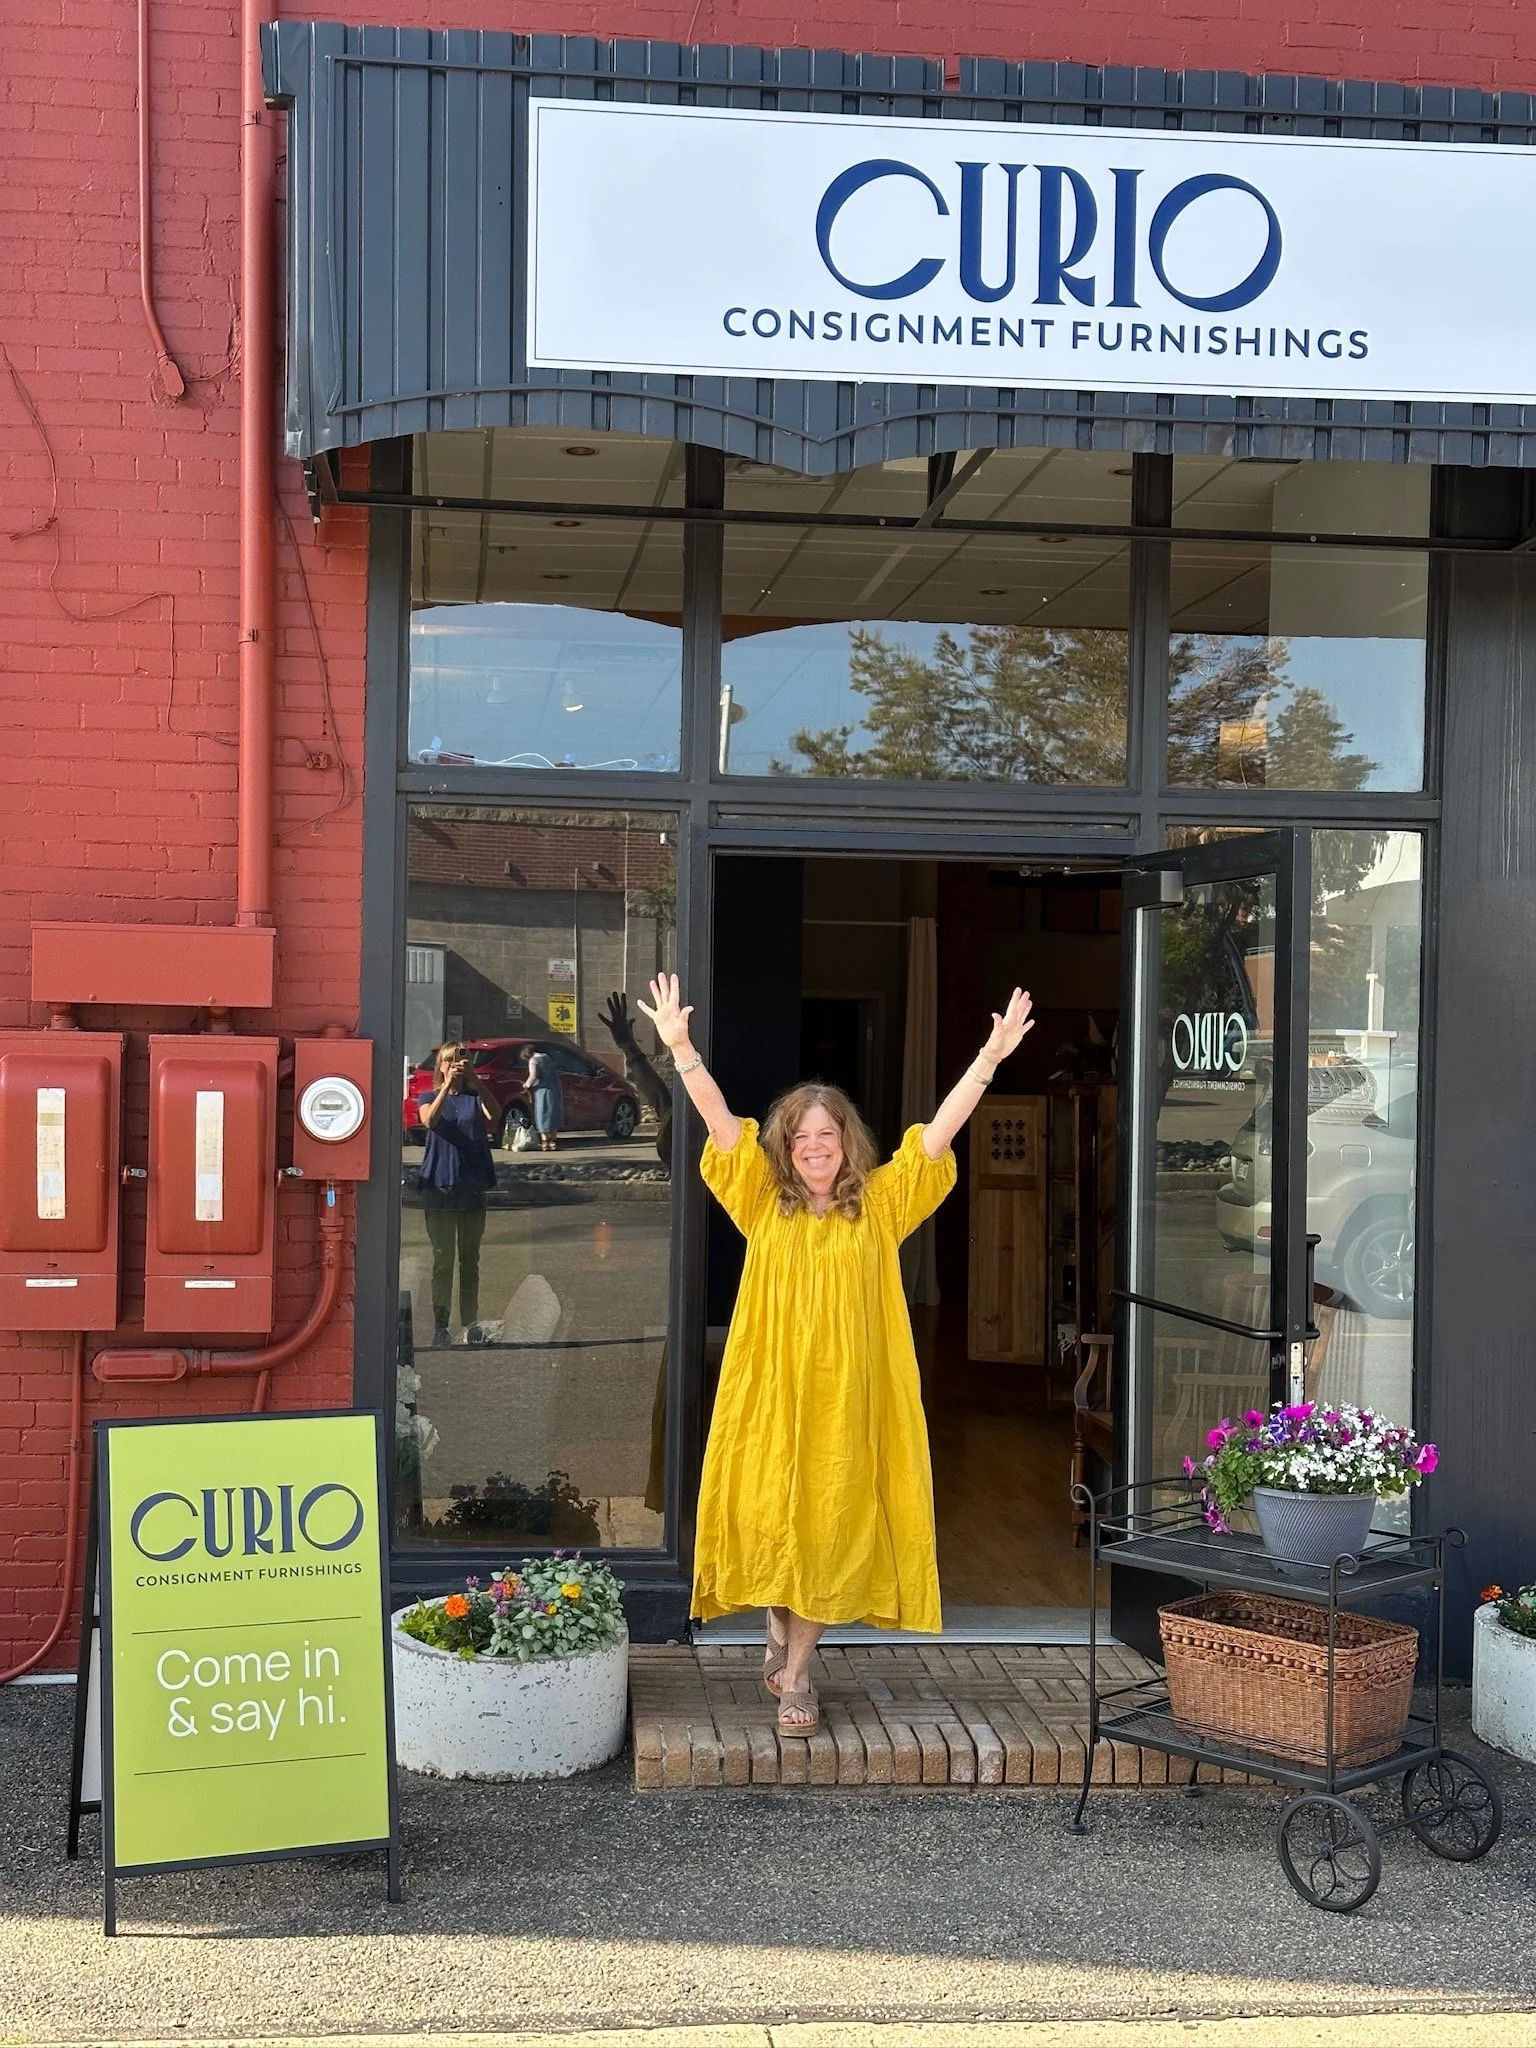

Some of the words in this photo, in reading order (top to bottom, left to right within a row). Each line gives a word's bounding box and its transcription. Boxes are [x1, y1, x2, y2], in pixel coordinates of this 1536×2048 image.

[815, 158, 1283, 313] CURIO
[723, 307, 1055, 349] CONSIGNMENT
[1072, 320, 1369, 360] FURNISHINGS
[130, 1483, 364, 1562] CURIO
[136, 1569, 254, 1587] CONSIGNMENT
[258, 1562, 362, 1580] FURNISHINGS
[156, 1649, 291, 1691] Come
[303, 1640, 340, 1679] in
[167, 1696, 199, 1738] &
[210, 1698, 286, 1741] say
[298, 1684, 347, 1726] hi.
